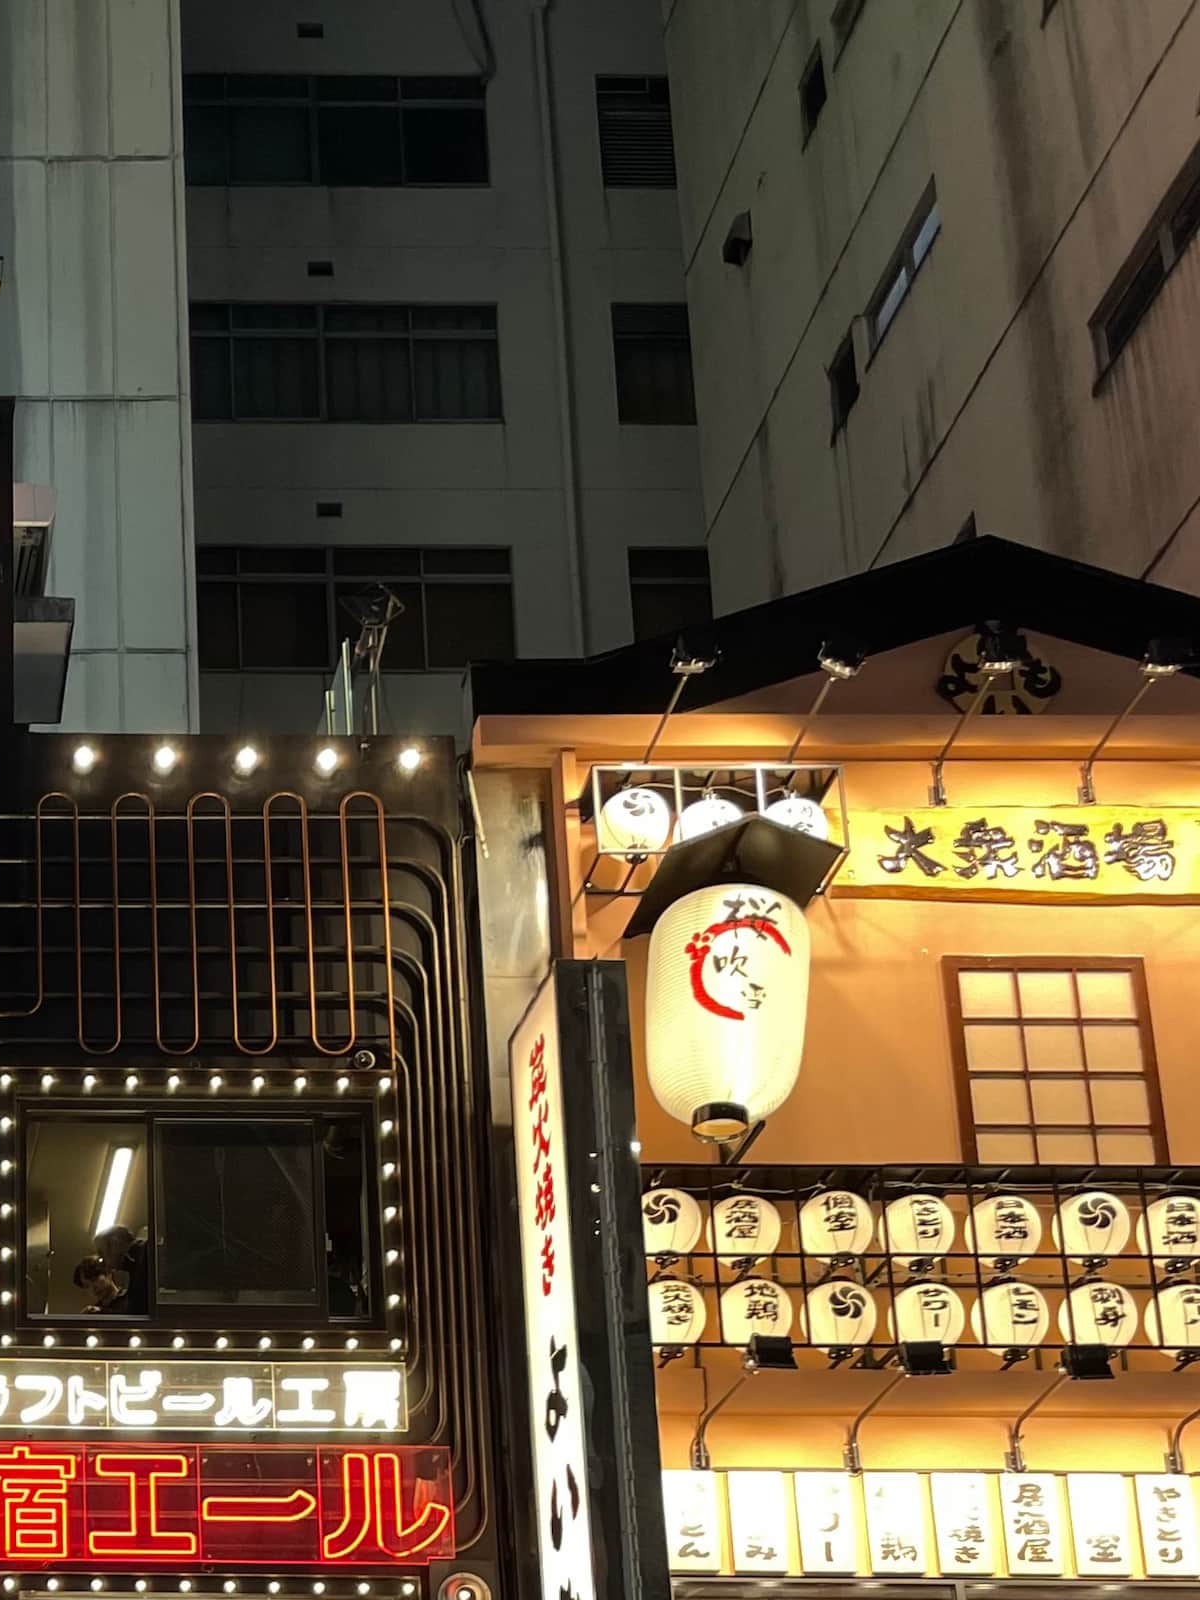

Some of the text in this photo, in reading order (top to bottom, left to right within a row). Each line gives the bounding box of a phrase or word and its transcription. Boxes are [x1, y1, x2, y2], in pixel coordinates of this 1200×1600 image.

[876, 815, 1176, 882] 大衆酒場
[528, 1032, 557, 1297] 炭火焼き
[725, 1199, 759, 1239] 居酒屋
[994, 1199, 1029, 1240] 日本酒
[1162, 1202, 1198, 1245] 日本酒
[743, 1282, 779, 1322] 地鶏
[1089, 1286, 1127, 1328] 刺身
[1011, 1483, 1054, 1563] 居酒屋
[1152, 1486, 1184, 1563] やきとり
